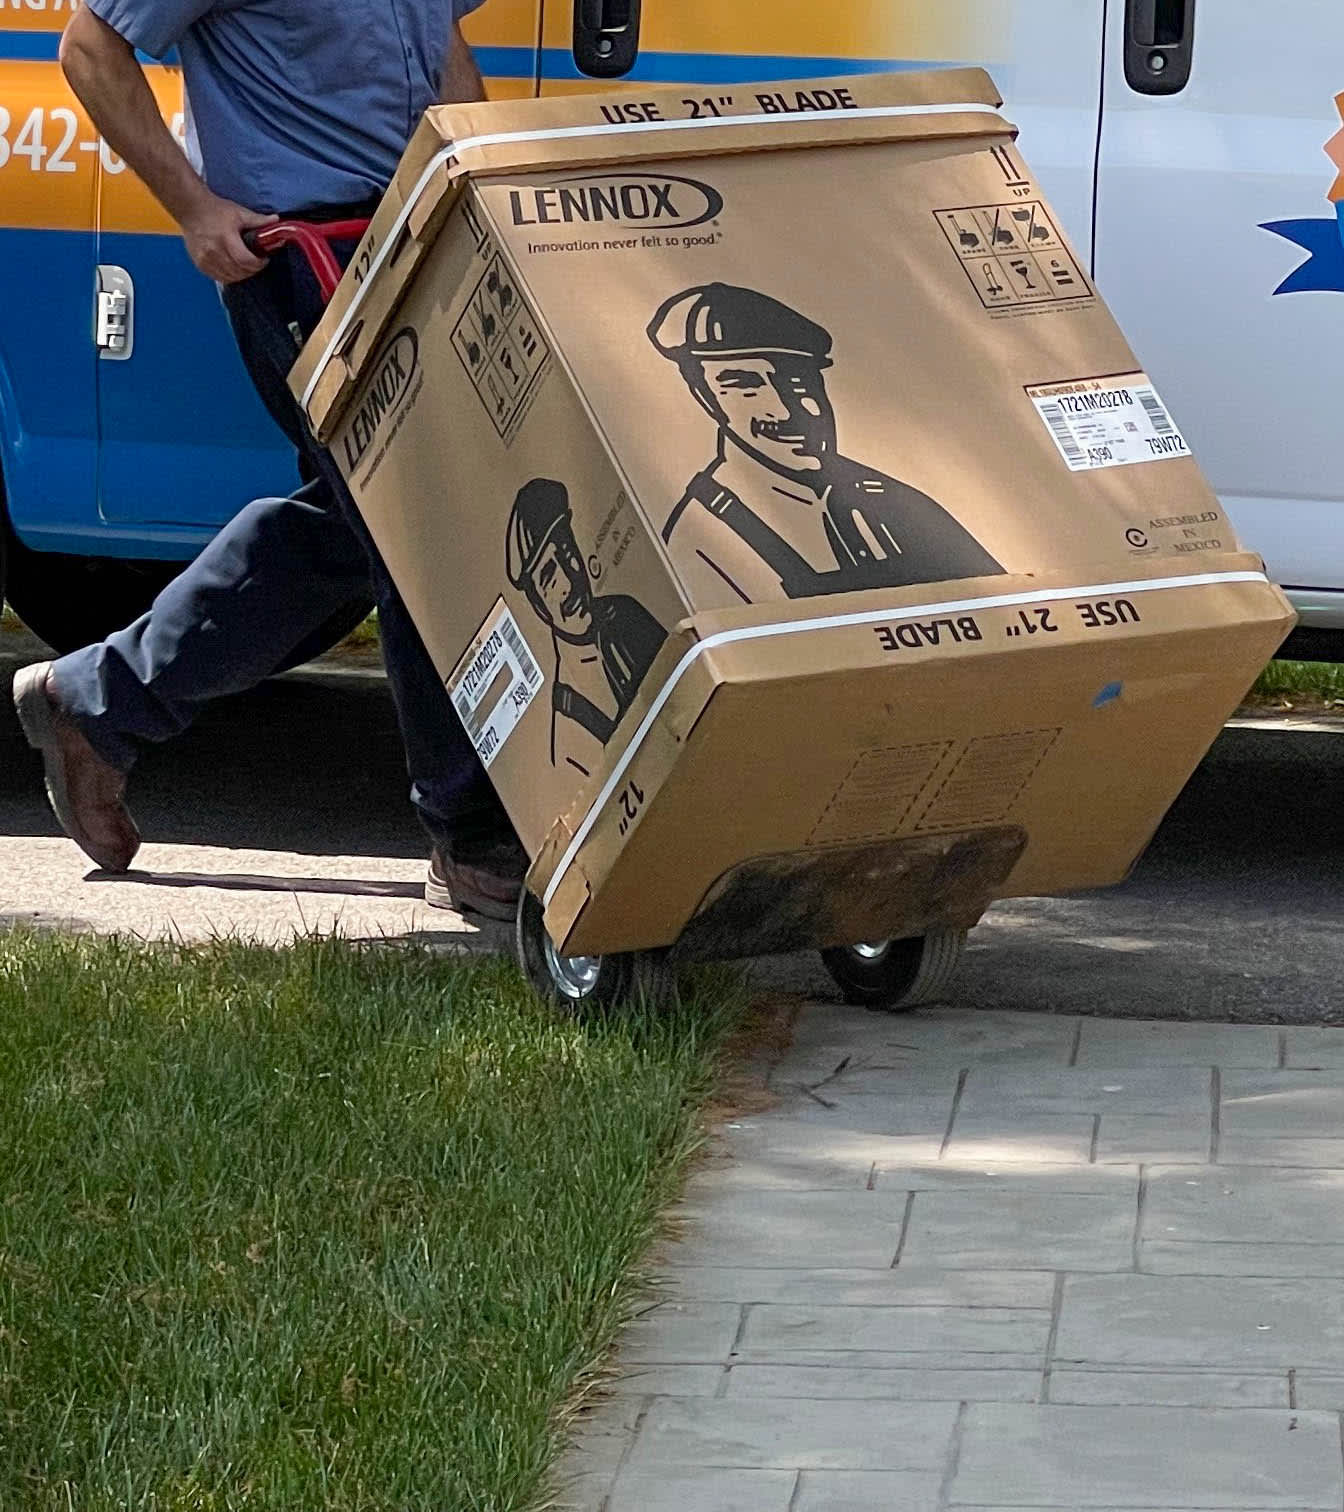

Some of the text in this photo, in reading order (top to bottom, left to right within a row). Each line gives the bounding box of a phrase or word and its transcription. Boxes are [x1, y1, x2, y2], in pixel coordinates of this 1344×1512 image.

[600, 87, 858, 125] USE 21" BLADE
[509, 183, 680, 226] LENNOX
[1012, 187, 1031, 197] UP
[527, 239, 601, 254] Innovation
[603, 239, 638, 251] never
[641, 235, 662, 248] felt
[665, 236, 679, 246] so
[343, 345, 407, 473] LENNOX
[1057, 389, 1135, 414] 1721M20278
[1145, 435, 1186, 456] 79W72
[1148, 511, 1218, 529] ASSEMBLED
[1173, 539, 1222, 553] MEXICO
[1075, 599, 1141, 628] USE
[873, 616, 984, 651] BLADE
